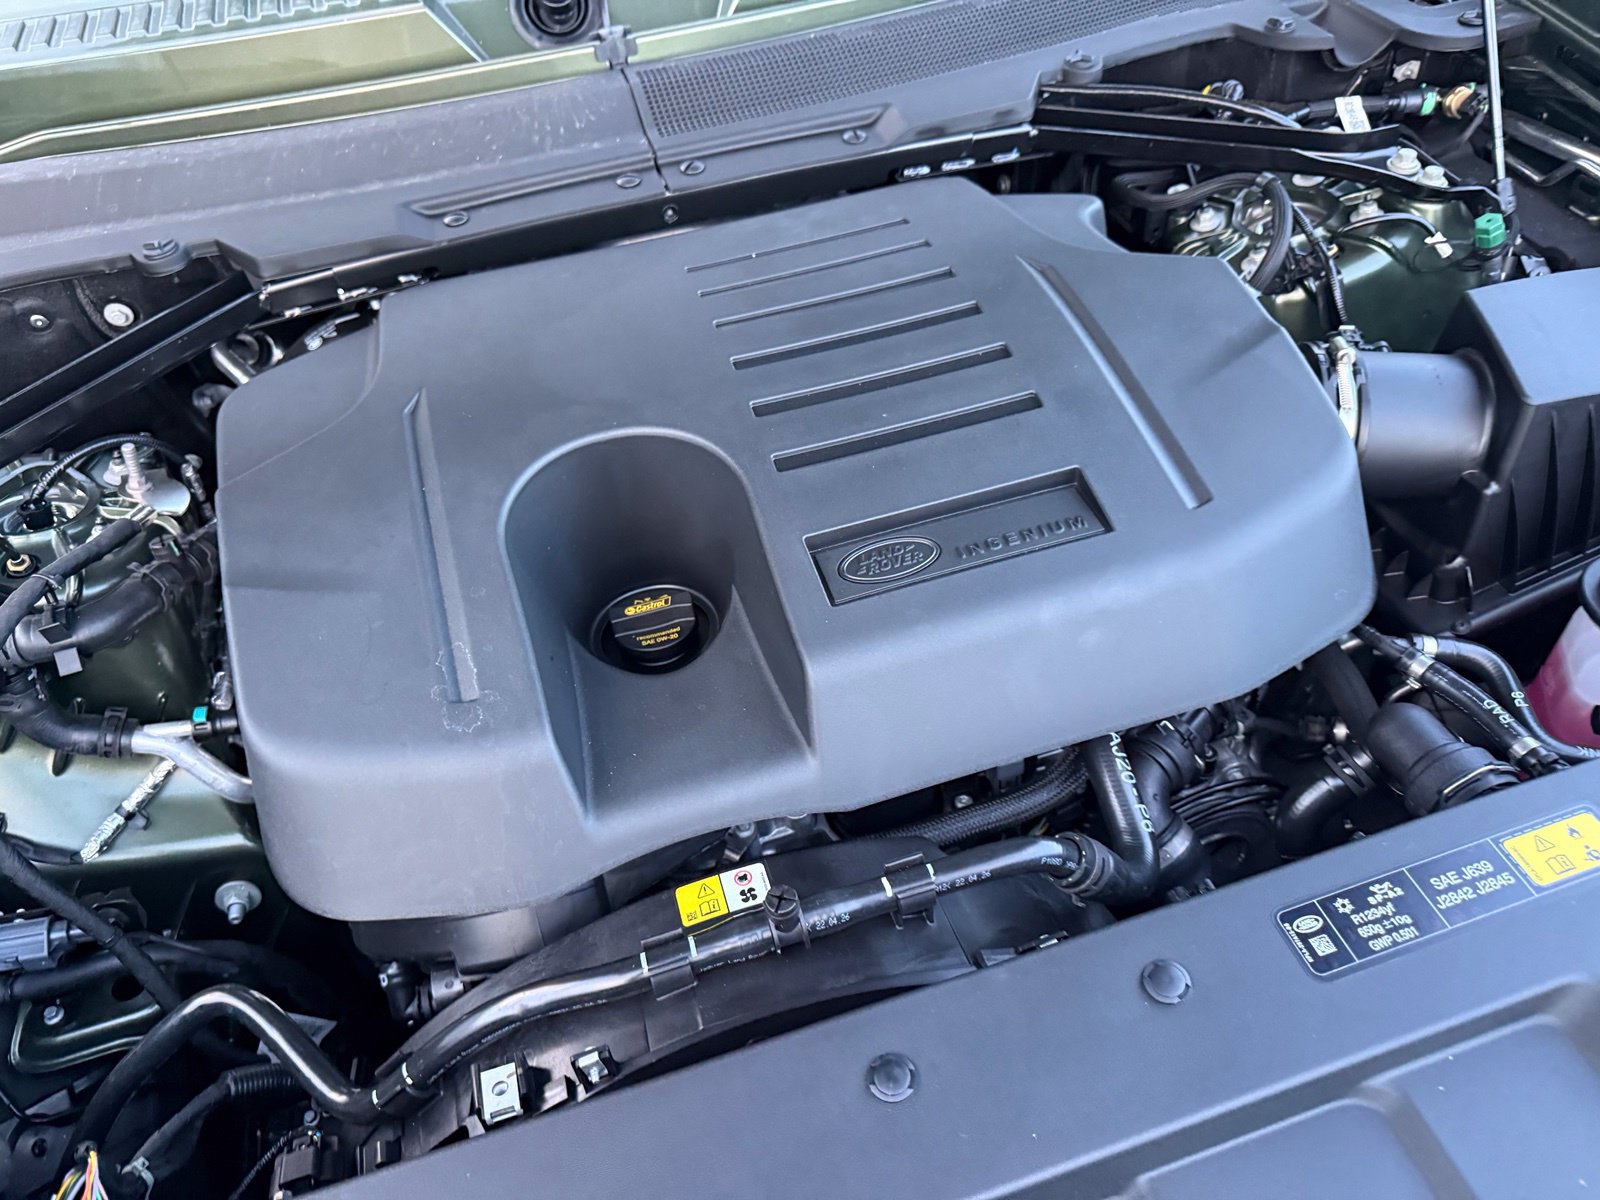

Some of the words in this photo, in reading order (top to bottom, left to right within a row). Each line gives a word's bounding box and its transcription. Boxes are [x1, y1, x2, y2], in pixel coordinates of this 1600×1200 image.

[955, 516, 1089, 559] INGENIUM
[859, 544, 905, 566] LAND
[867, 551, 924, 576] ROVER
[636, 600, 665, 612] Castrol
[637, 626, 680, 640] recommended
[656, 633, 679, 642] 0W-20
[1430, 871, 1462, 890] SAE
[1460, 860, 1495, 881] J639
[1435, 887, 1477, 909] J2842
[1476, 872, 1516, 895] J2845
[1350, 902, 1396, 925] R1234yf
[1356, 923, 1387, 938] 650g
[1367, 935, 1394, 952] GWP
